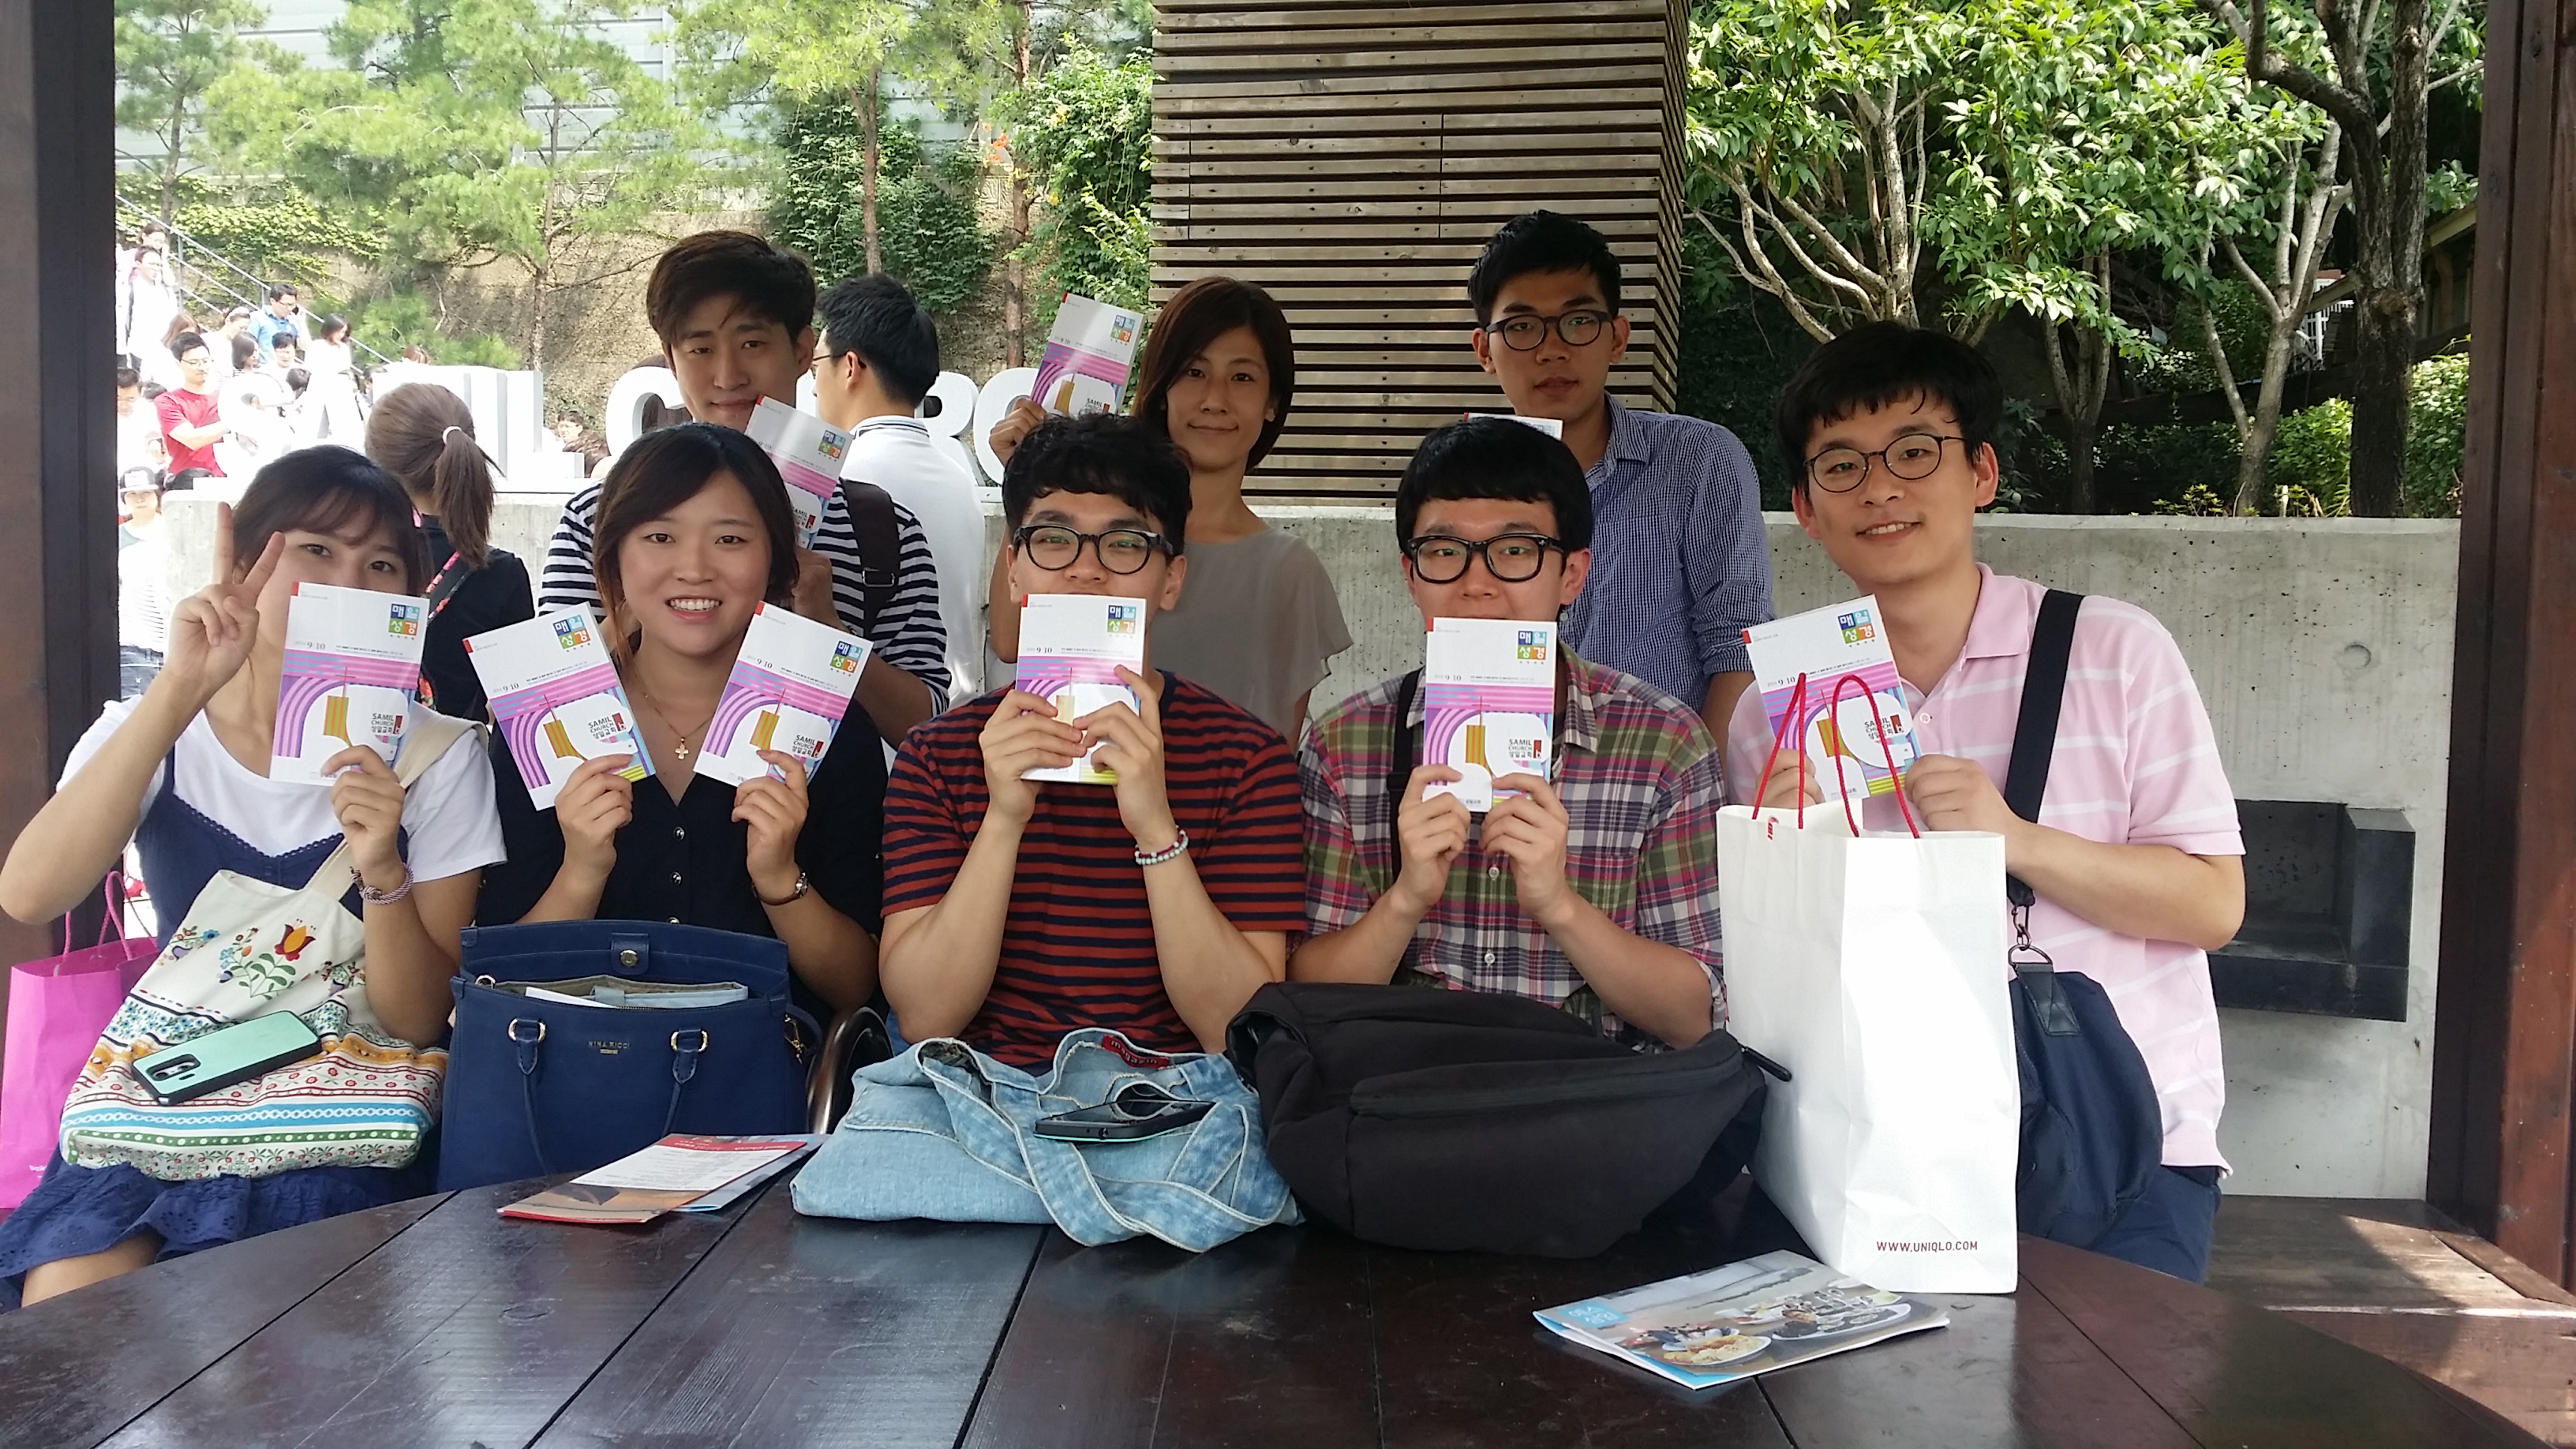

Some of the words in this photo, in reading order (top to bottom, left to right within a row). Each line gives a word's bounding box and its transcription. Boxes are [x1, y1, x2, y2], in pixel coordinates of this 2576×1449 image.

[391, 604, 420, 621] 매일
[1109, 606, 1136, 619] 매일
[1840, 610, 1870, 627] 매일
[390, 620, 417, 635] 성경
[555, 615, 583, 635] 매일
[1109, 620, 1135, 632] 성경
[560, 630, 590, 647] 성경
[1518, 631, 1546, 645] 매일
[1844, 624, 1874, 642] 성경
[837, 642, 863, 659] 매일
[1518, 646, 1546, 660] 성경
[833, 656, 858, 672] 성경
[373, 713, 395, 721] SAMIL
[588, 717, 612, 728] SAMIL
[1864, 717, 1889, 728] SAIL
[590, 722, 615, 733] CHURCH
[793, 740, 814, 751] CHURCH
[796, 735, 816, 745] SAMIL
[1877, 1241, 1978, 1252] WWW.UNIQLO.COM
